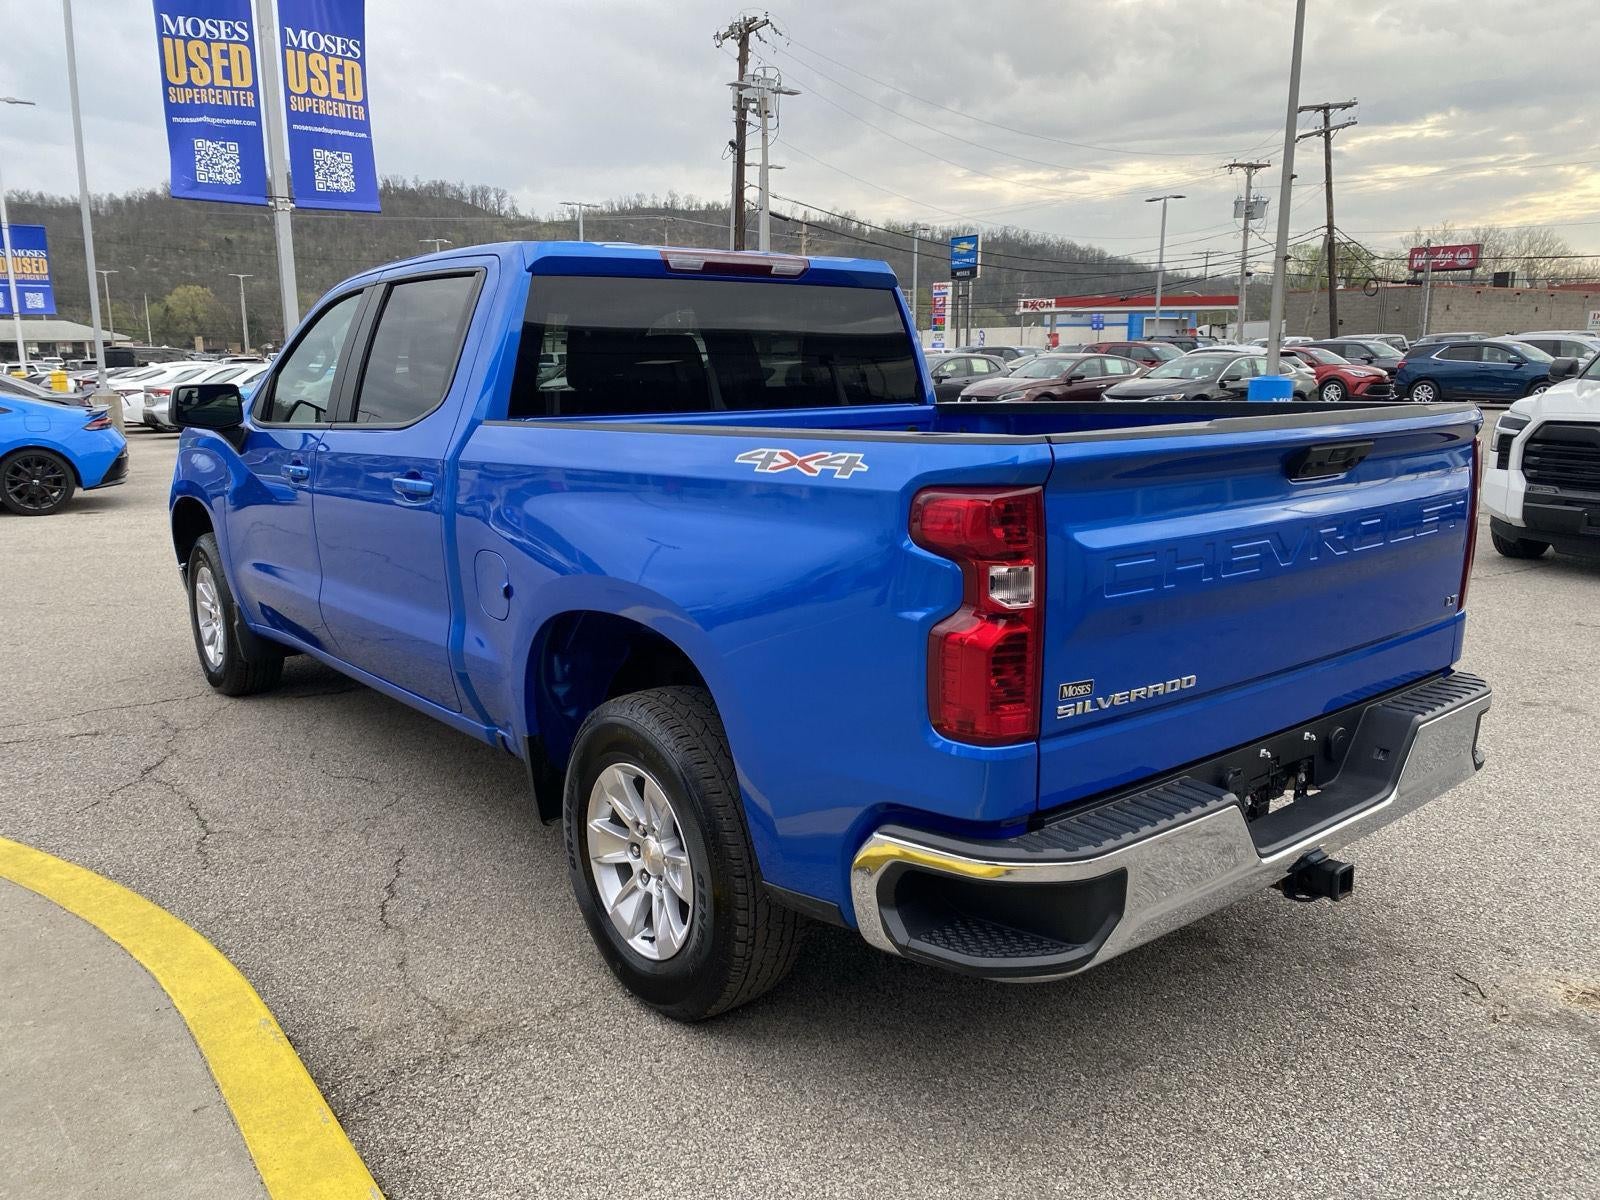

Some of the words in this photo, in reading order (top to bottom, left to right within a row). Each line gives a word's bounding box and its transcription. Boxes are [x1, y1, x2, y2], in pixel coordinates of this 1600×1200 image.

[160, 13, 249, 42] MOSES
[284, 26, 361, 59] MOSES
[162, 37, 253, 88] USED
[285, 48, 364, 103] USED
[168, 86, 255, 108] SUPERCENTER
[290, 95, 365, 121] SUPERCENTER
[172, 115, 257, 127] mosesusedsupercenter.com
[292, 123, 367, 138] mosesusedsupercenter.com
[12, 248, 47, 258] MOSES
[12, 256, 48, 275] USED
[1022, 300, 1054, 311] EXXON
[1104, 500, 1465, 599] CHEVROLET
[1056, 674, 1197, 720] SILVERADO
[1062, 683, 1091, 699] MOSES
